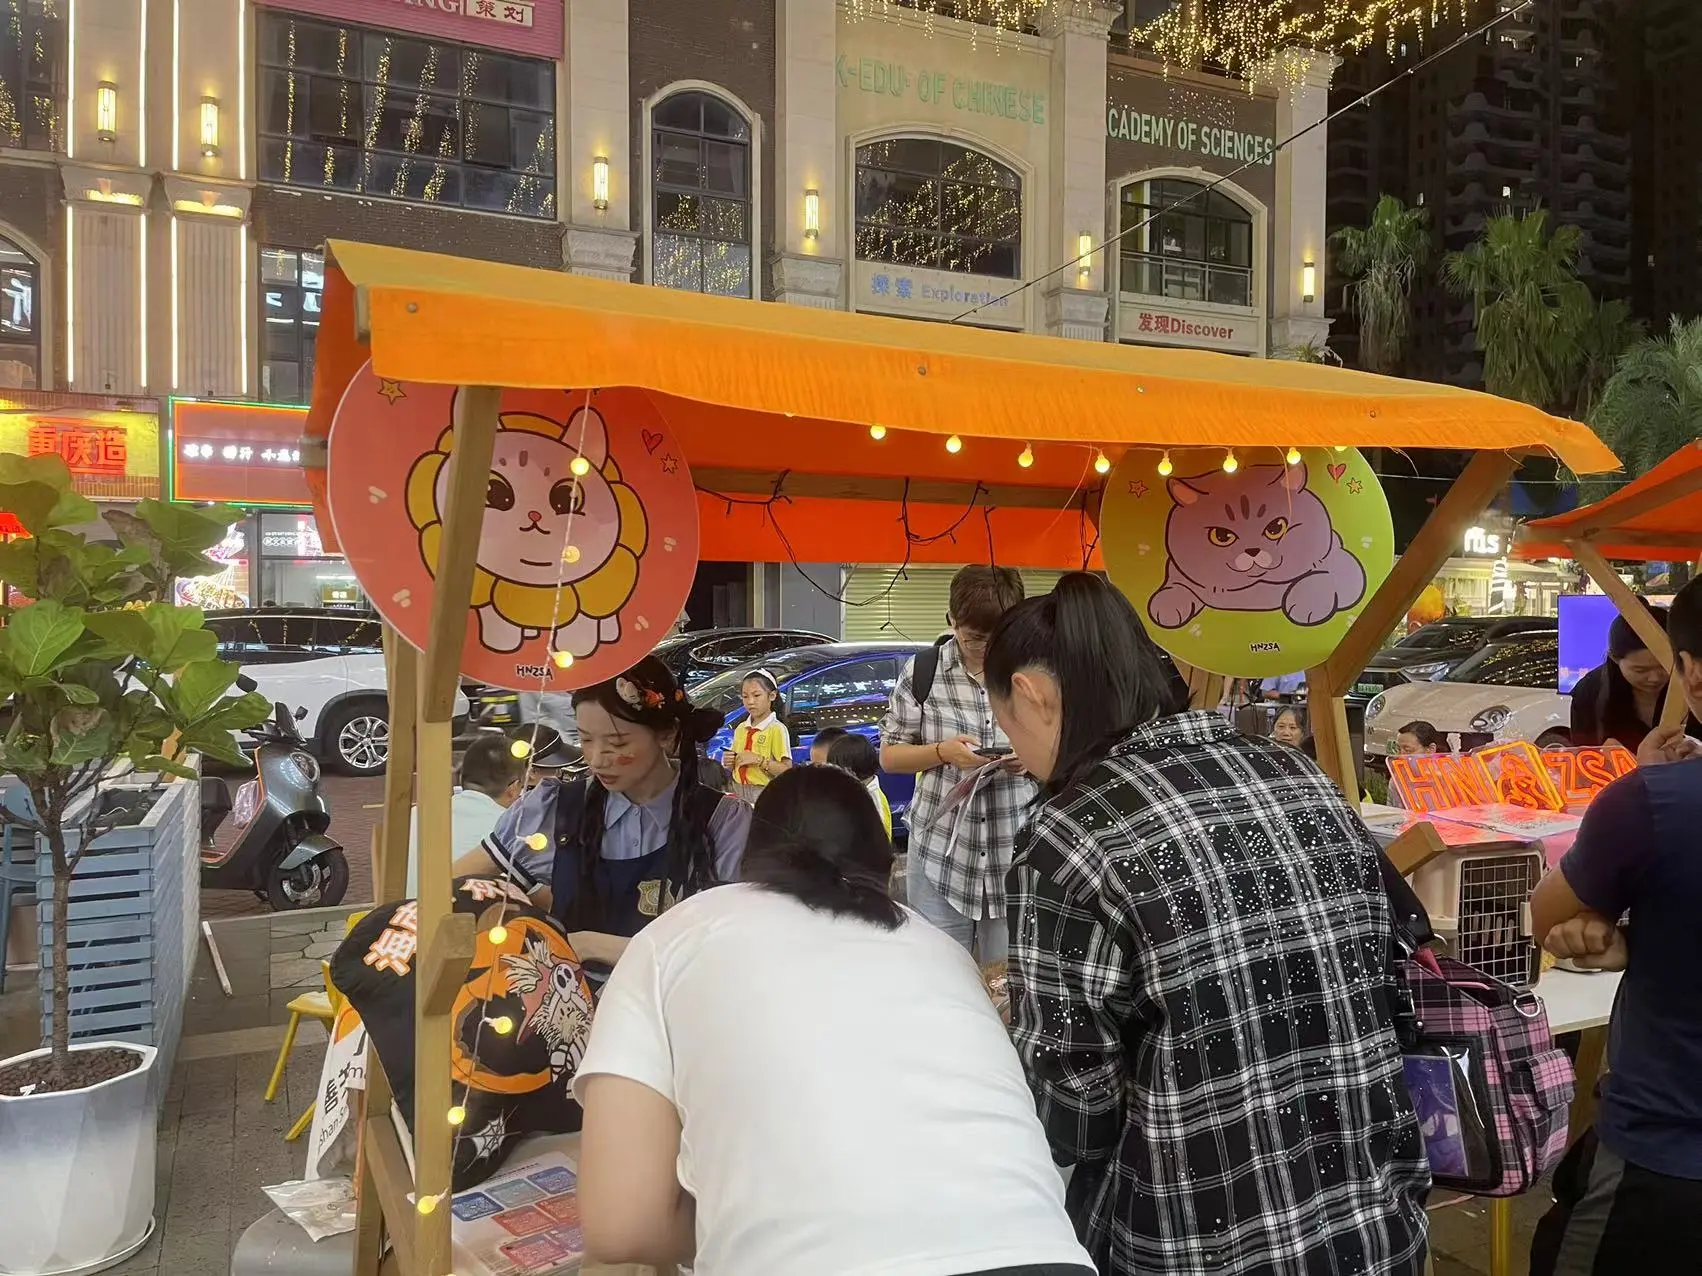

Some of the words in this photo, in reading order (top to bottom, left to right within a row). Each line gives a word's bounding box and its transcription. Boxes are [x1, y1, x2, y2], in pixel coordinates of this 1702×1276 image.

[918, 70, 946, 105] OF
[952, 77, 1044, 124] CHINESE
[1106, 107, 1175, 148] CADEMY
[1177, 120, 1198, 151] OF
[1201, 126, 1273, 166] SCIENCES
